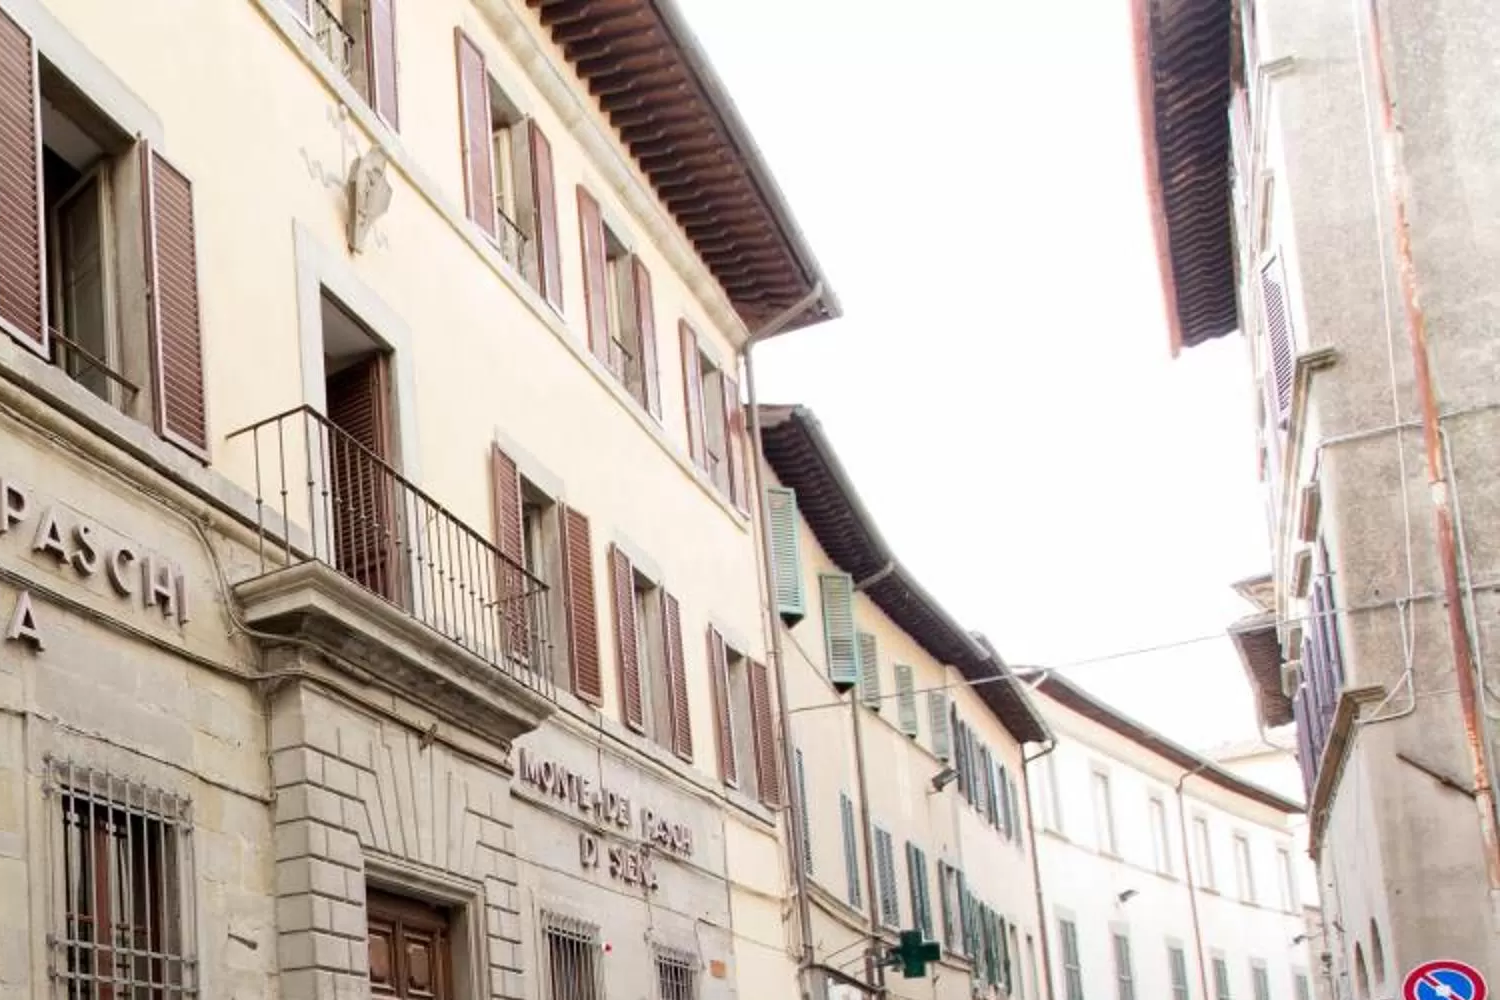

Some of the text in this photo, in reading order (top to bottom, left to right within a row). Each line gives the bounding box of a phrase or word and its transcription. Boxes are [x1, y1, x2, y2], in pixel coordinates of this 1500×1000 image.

[519, 747, 592, 812] MONTE
[602, 787, 633, 829] DEI
[579, 832, 660, 896] DI SIENA
